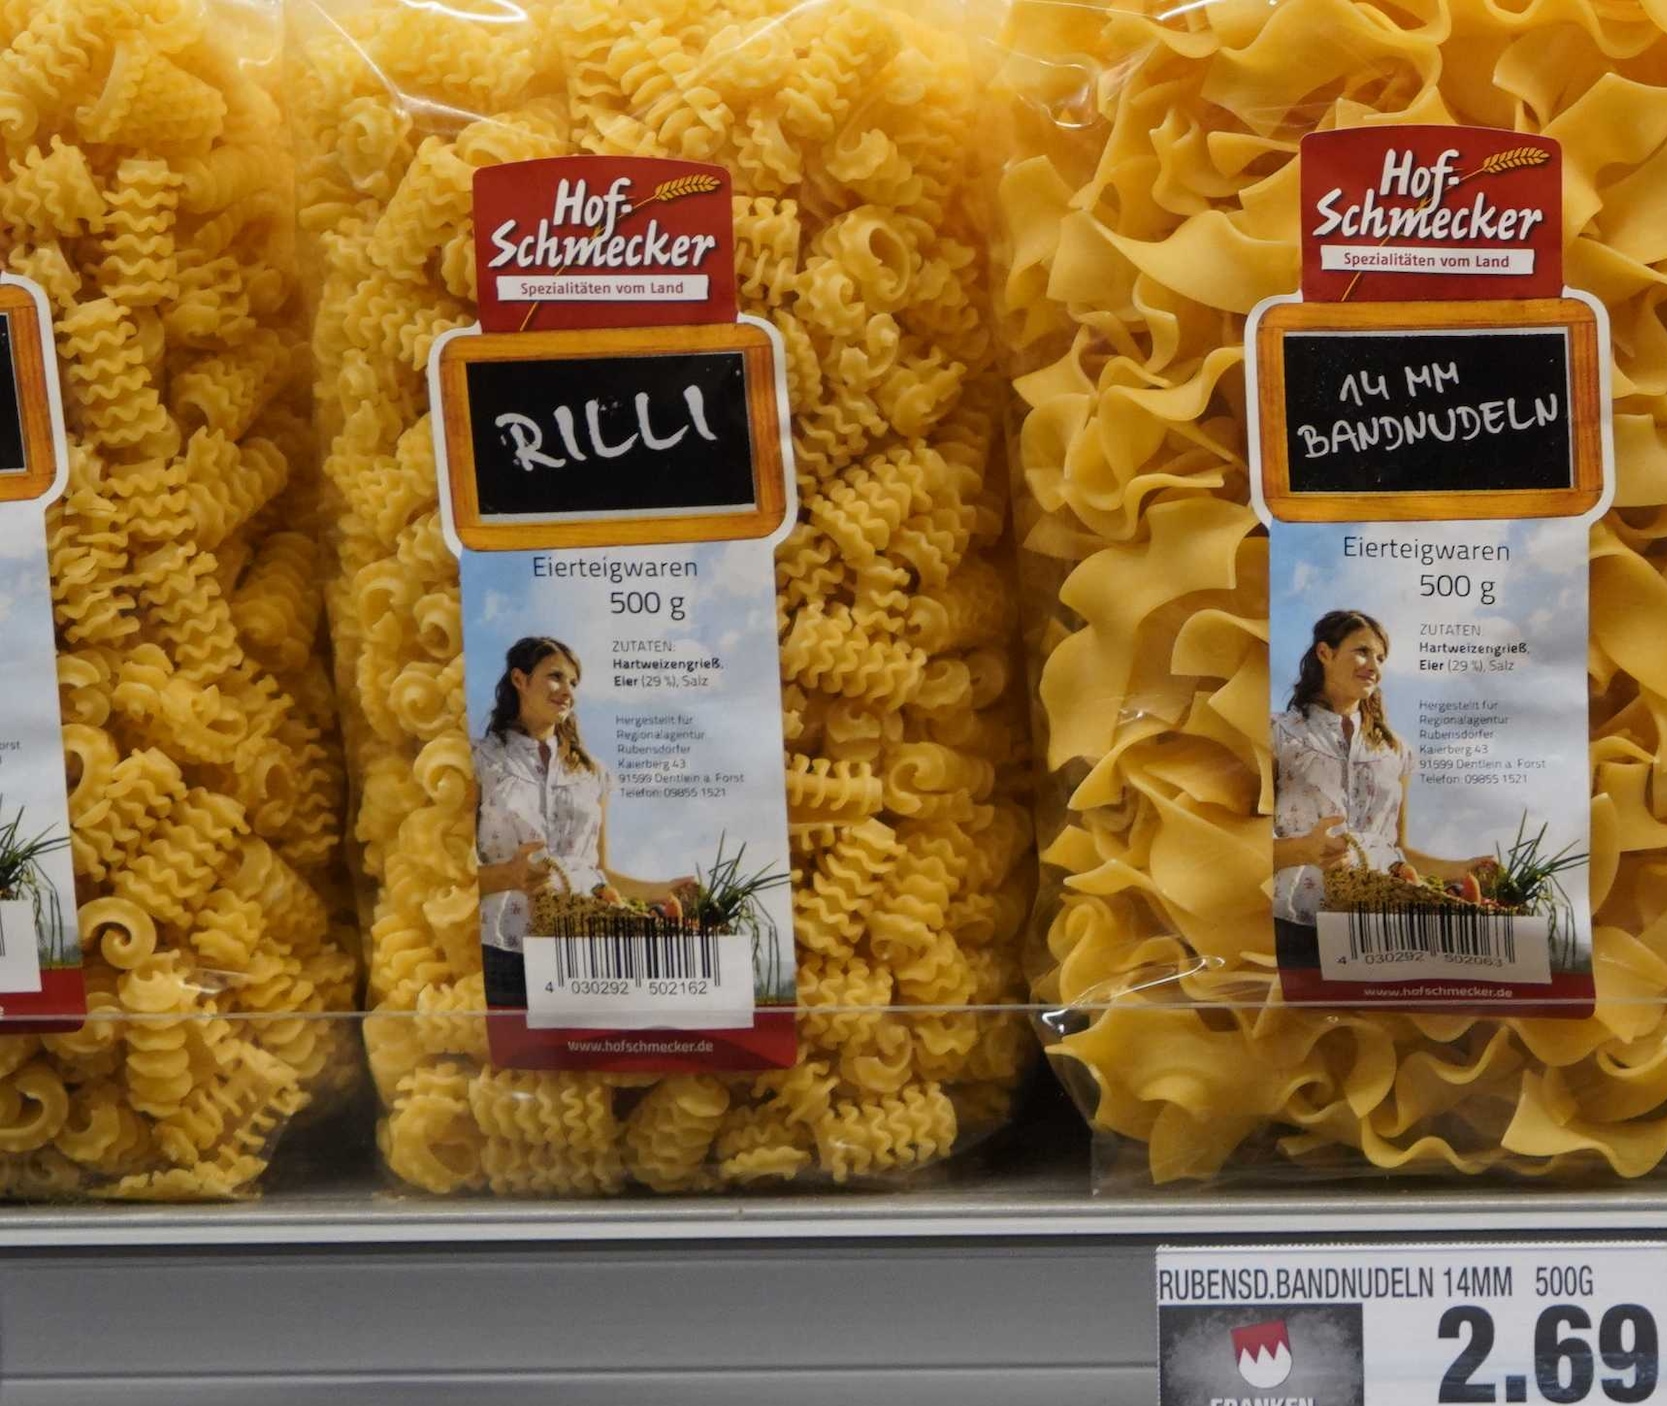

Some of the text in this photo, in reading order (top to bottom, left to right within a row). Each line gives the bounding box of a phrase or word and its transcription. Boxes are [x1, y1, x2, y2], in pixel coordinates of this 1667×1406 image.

[1380, 148, 1460, 211] Hof-
[553, 178, 632, 238] Hof-
[1313, 187, 1542, 240] Schmecker
[488, 219, 715, 268] Schmecker
[520, 281, 683, 296] Spezialitäten vom Land
[1339, 361, 1459, 406] 14 MM
[495, 385, 718, 471] RILLI
[1297, 393, 1558, 458] BANDNUDELN
[533, 557, 698, 582] Eierteigwaren
[1343, 536, 1510, 565] Eierteigwaren
[610, 592, 685, 619] 500 g
[1419, 575, 1496, 604] 500 g
[545, 980, 707, 994] 4 030292 502162
[1159, 1265, 1594, 1300] RUBENSD.BANDNUDELN 14MM 500G
[1438, 1304, 1659, 1405] 2.69
